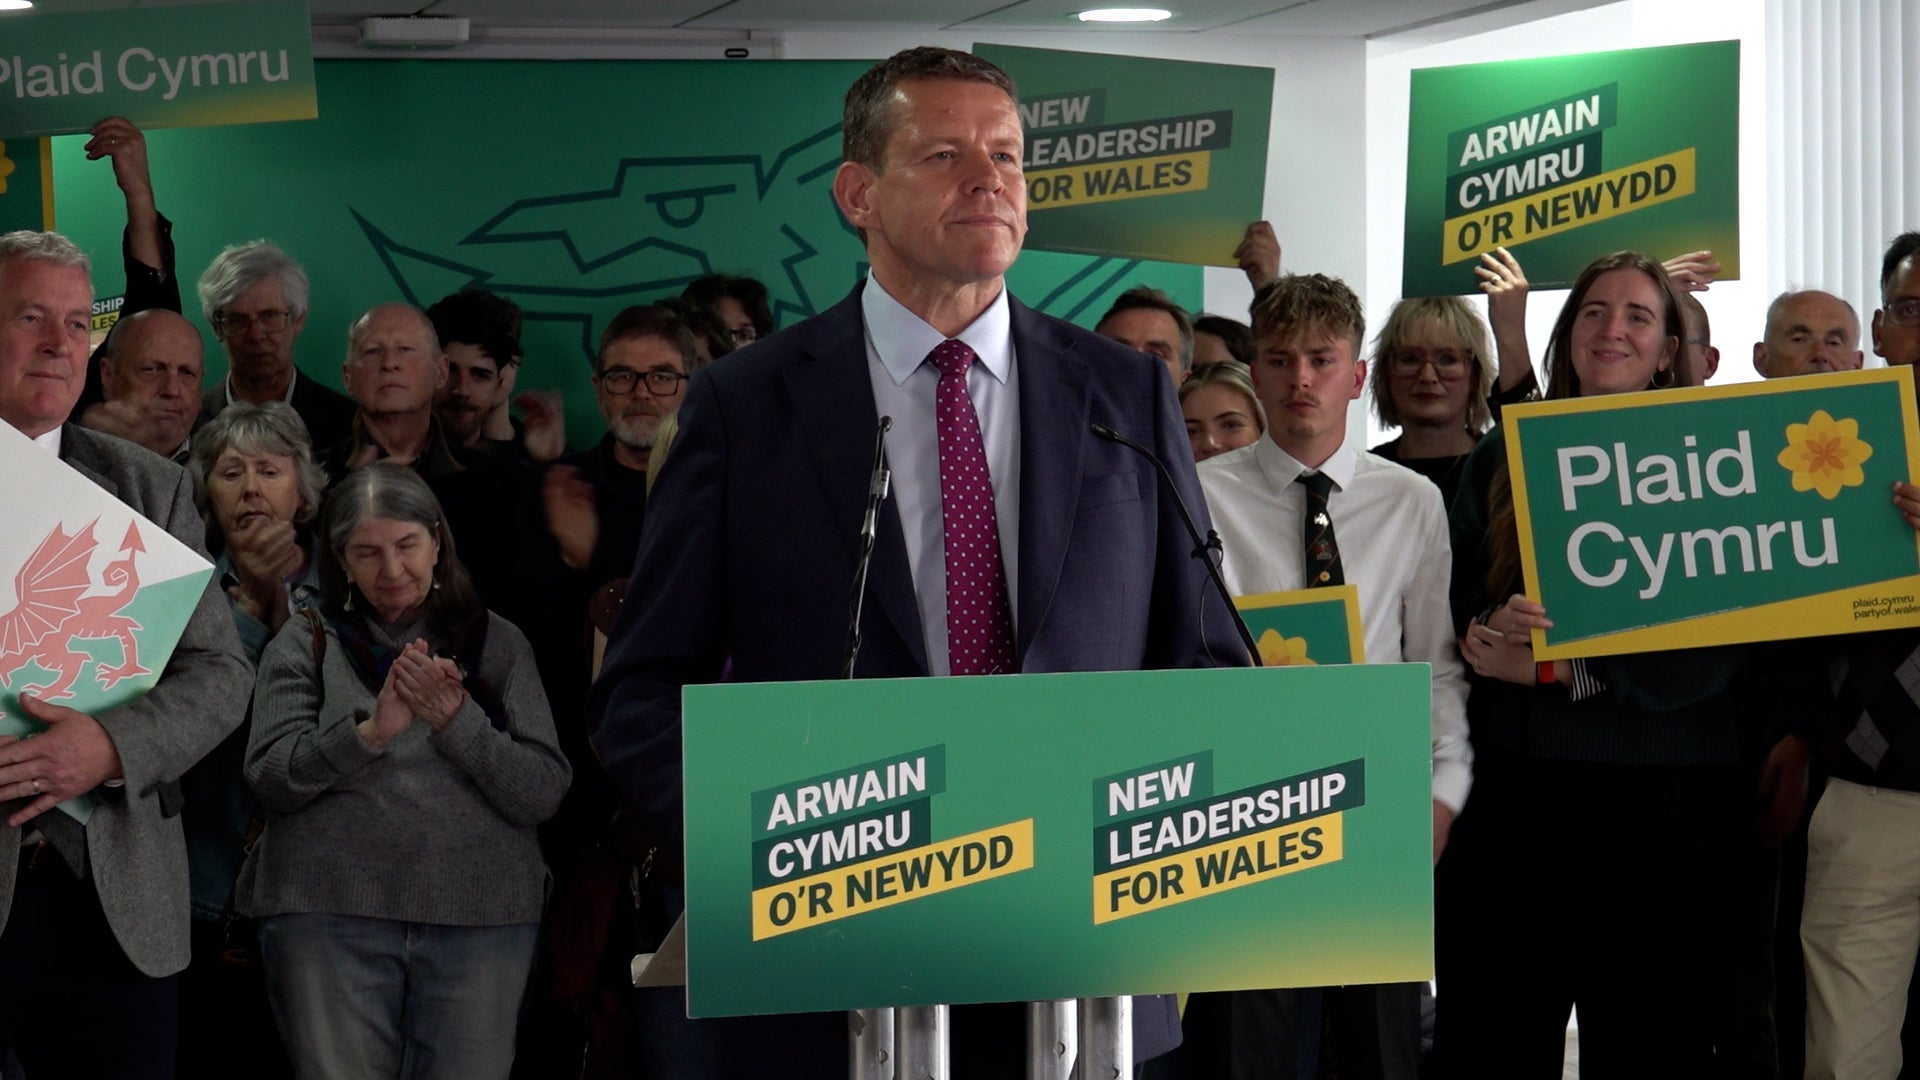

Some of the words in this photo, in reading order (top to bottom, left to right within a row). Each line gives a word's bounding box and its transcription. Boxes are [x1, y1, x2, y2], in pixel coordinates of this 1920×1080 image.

[117, 47, 289, 100] Cymru
[1017, 96, 1091, 129] NEW
[1023, 119, 1216, 167] EADERSHIP
[1459, 94, 1600, 167] ARWAIN
[1027, 174, 1073, 204] OR
[1083, 160, 1192, 197] WALES
[1459, 143, 1585, 209] CYMRU
[1525, 163, 1677, 234] NEWYDD
[1557, 430, 1756, 511] Plaid
[1566, 517, 1839, 600] Cymru
[1853, 596, 1914, 610] plaid.cymru
[766, 757, 926, 831] ARWAIN
[1108, 762, 1195, 817] NEW
[1110, 772, 1346, 864] LEADERSHIP
[768, 810, 911, 878] CYMRU
[846, 835, 1014, 908] NEWYDD
[1111, 864, 1184, 913] FOR
[1195, 826, 1324, 889] WALES
